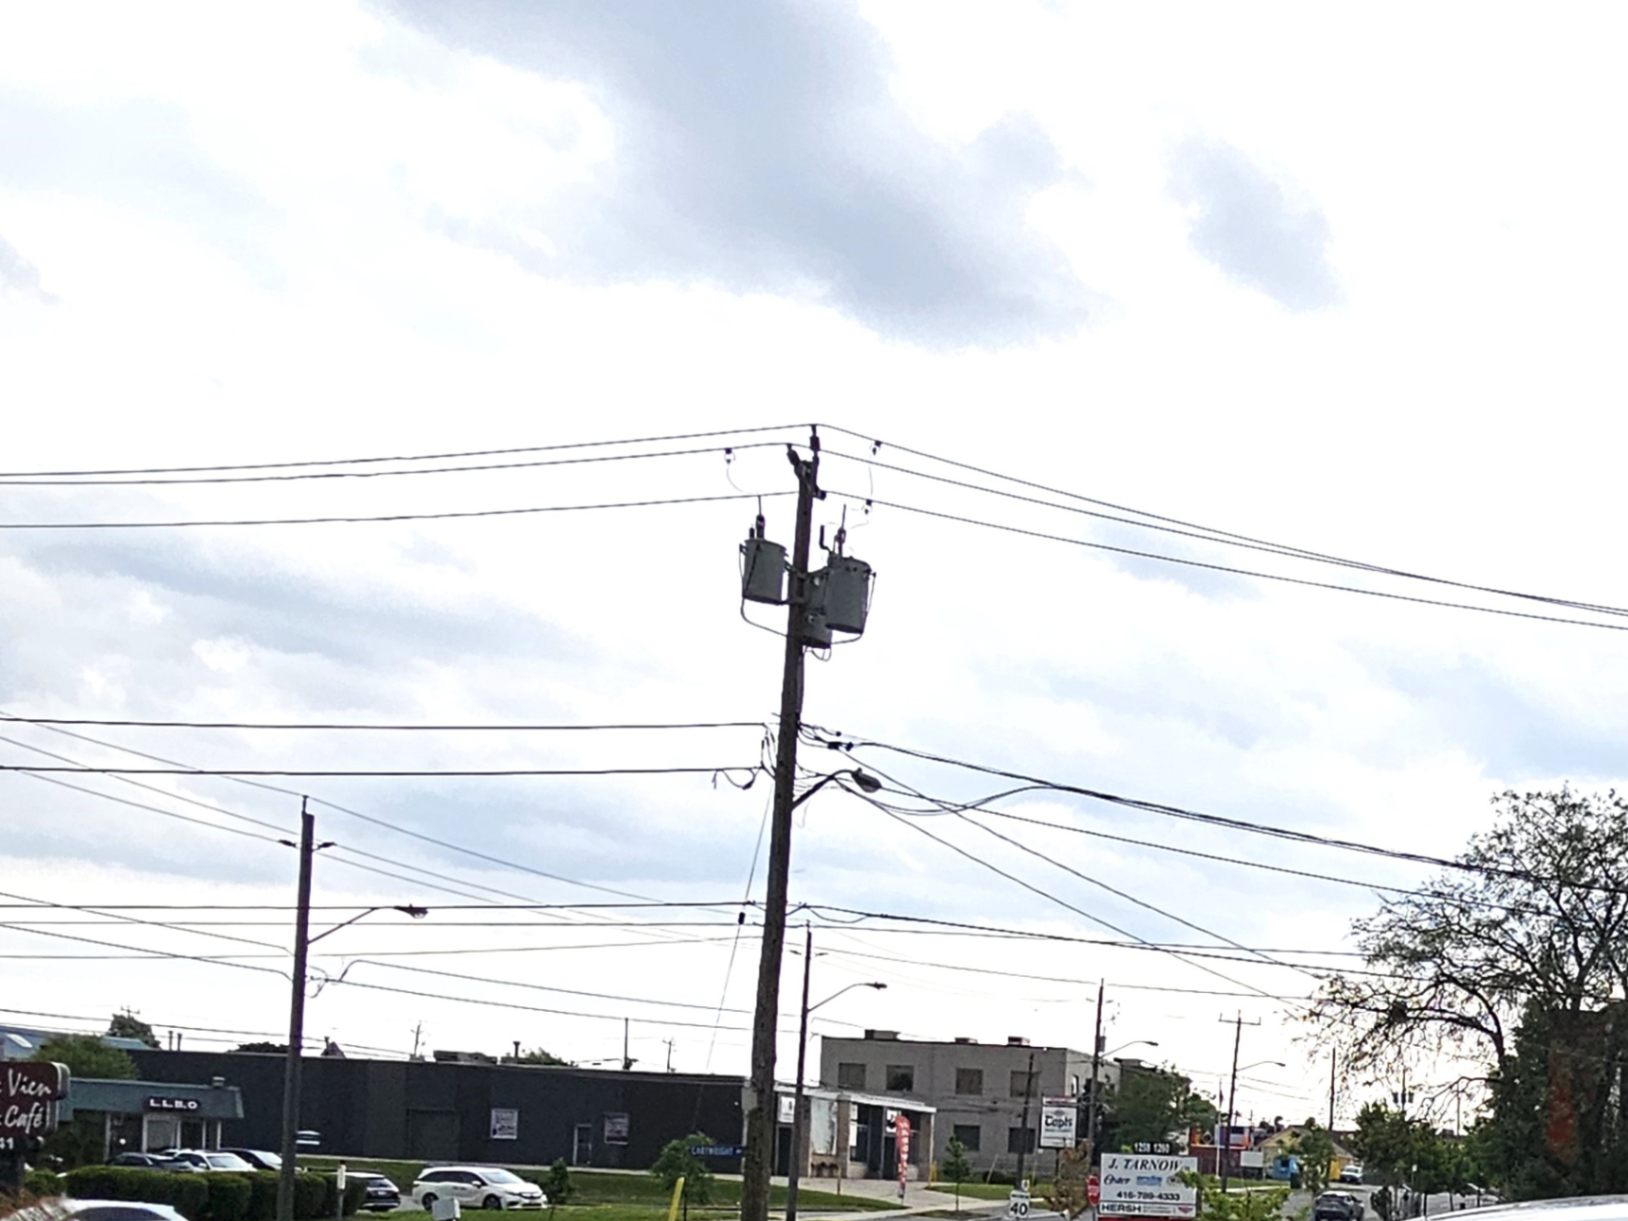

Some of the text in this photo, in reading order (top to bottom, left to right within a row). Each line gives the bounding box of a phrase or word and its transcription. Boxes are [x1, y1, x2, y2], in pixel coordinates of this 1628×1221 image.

[4, 1102, 44, 1134] Café
[1124, 1159, 1182, 1171] TARNOW
[1010, 1202, 1028, 1216] 40
[1101, 1203, 1141, 1212] HERSH
